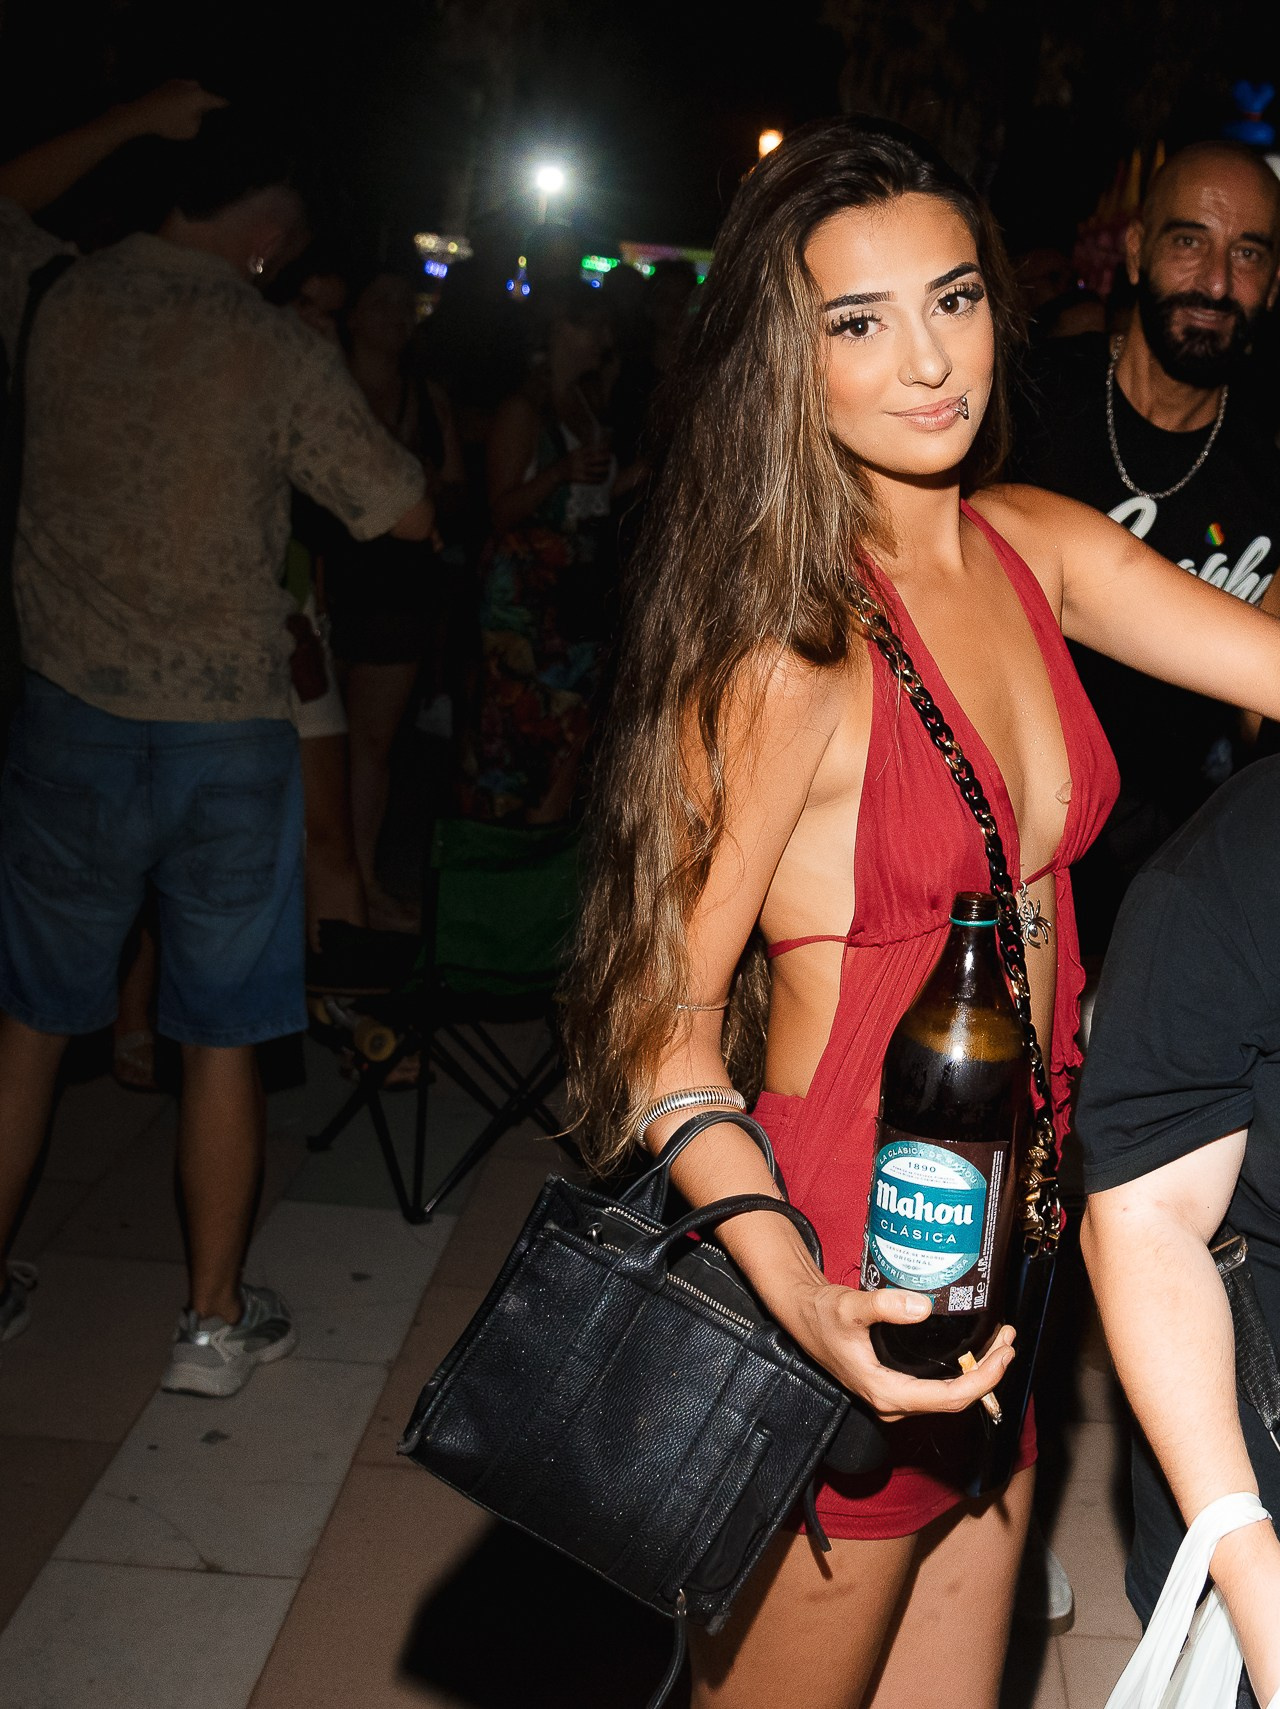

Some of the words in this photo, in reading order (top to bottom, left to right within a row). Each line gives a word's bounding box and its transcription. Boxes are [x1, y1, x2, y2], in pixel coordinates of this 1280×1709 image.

[879, 1154, 888, 1165] LA
[888, 1146, 925, 1158] CLÁSICA
[907, 1161, 937, 1173] 1890
[876, 1179, 974, 1226] Mahou
[880, 1218, 958, 1244] CLÁSICA
[893, 1253, 932, 1267] ORIGINAL
